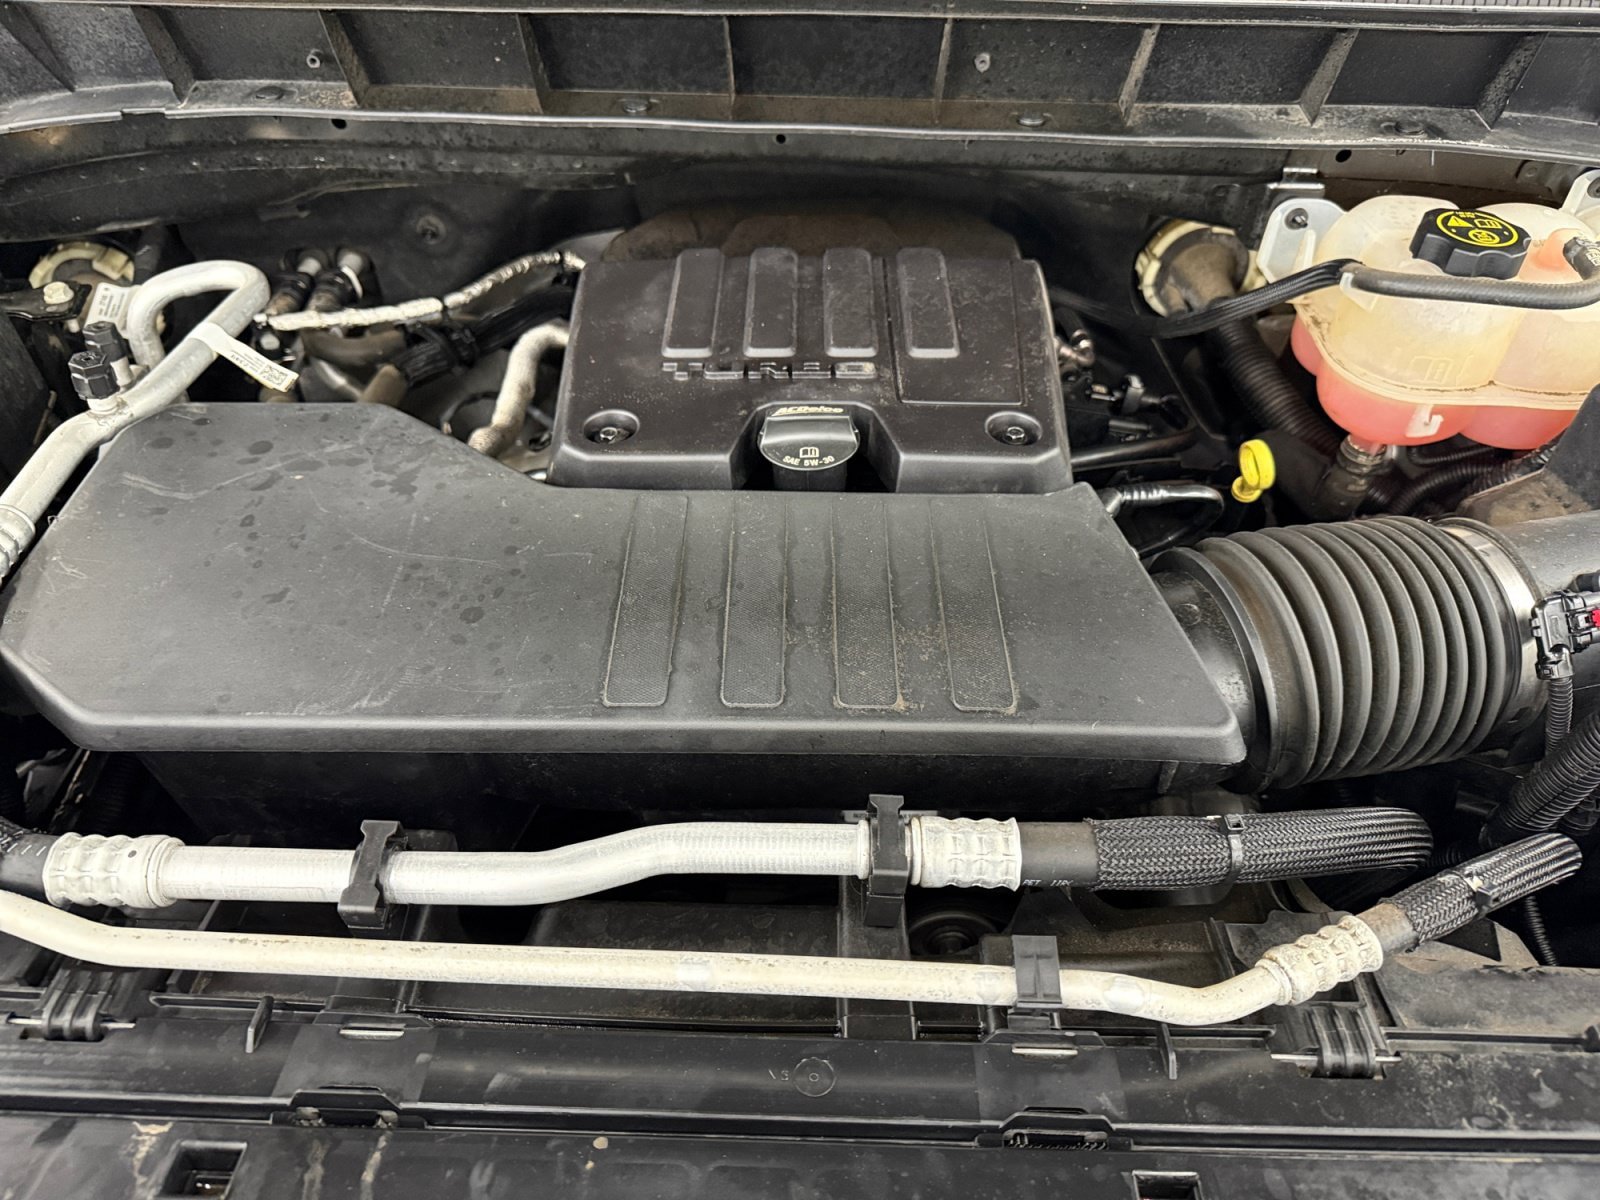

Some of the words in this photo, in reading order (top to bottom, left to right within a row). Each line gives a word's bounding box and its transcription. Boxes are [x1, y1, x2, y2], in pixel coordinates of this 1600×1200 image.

[771, 405, 844, 417] ACDelco
[782, 455, 801, 466] SAE
[803, 455, 835, 467] 5W-30
